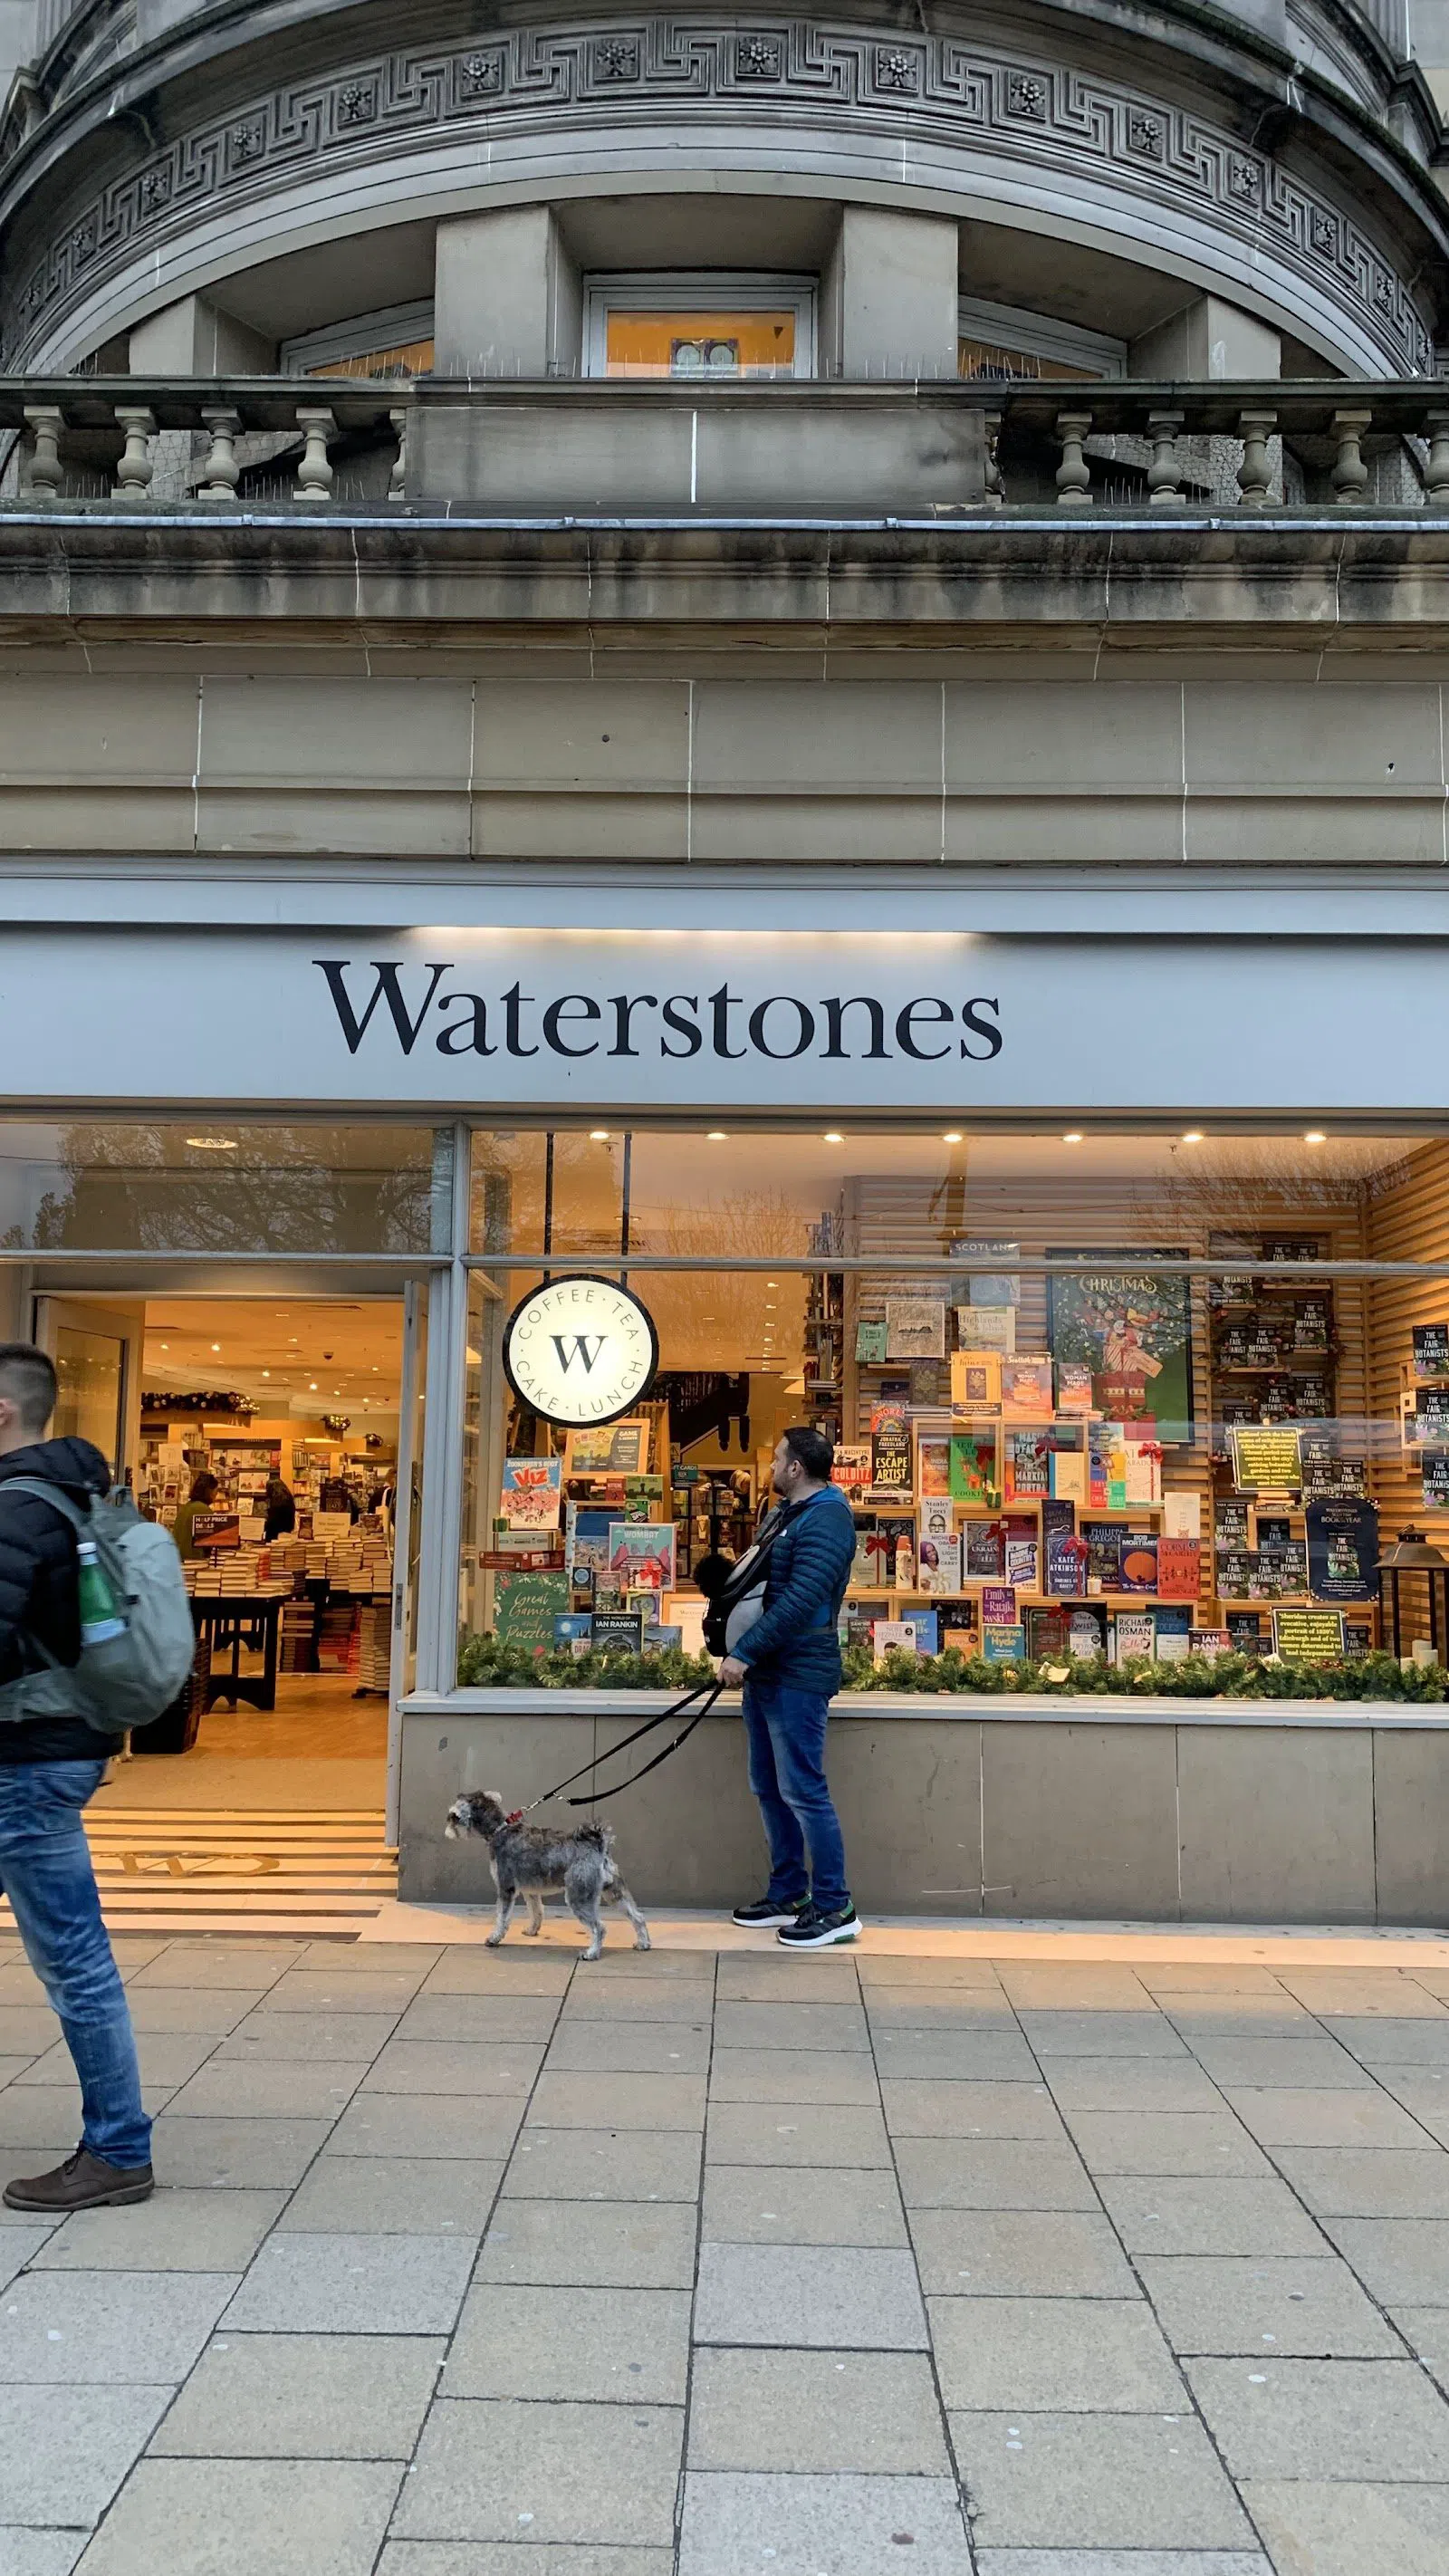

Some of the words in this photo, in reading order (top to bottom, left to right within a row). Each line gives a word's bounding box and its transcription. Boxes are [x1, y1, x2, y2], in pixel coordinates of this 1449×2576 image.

[312, 960, 1003, 1060] Waterstones
[1080, 1274, 1157, 1294] CHRISTMAS
[518, 1289, 595, 1340] COFFEE
[611, 1301, 638, 1340] TEA
[1425, 1331, 1436, 1340] THE
[1424, 1340, 1438, 1349] FAIR
[549, 1335, 609, 1374] W
[1415, 1349, 1449, 1359] BOTANISTS
[516, 1360, 560, 1411] CAKE
[578, 1360, 643, 1417] LUNCH
[1261, 1404, 1285, 1412] BOTANIST
[1426, 1405, 1441, 1413] FAIR
[876, 1456, 908, 1469] ESCAPE
[1435, 1462, 1445, 1470] THE
[834, 1467, 870, 1481] COLDITZ
[877, 1468, 907, 1480] ARTIST
[1015, 1471, 1048, 1481] MARRIA
[1434, 1470, 1447, 1479] FAIR
[1016, 1483, 1046, 1492] PORTRA
[1226, 1508, 1236, 1516] THE
[1224, 1516, 1238, 1524] FAIR
[1215, 1524, 1247, 1533] BOTANISTS
[1229, 1556, 1239, 1564] THE
[1260, 1557, 1270, 1565] THE
[1050, 1563, 1083, 1572] ATKINSON
[1258, 1565, 1271, 1573] FAIR
[1218, 1572, 1245, 1581] BOTANIST
[1250, 1573, 1281, 1582] BOTANISTS
[514, 1593, 549, 1605] Great
[984, 1589, 1005, 1600] Emily
[509, 1606, 552, 1620] Games
[1118, 1619, 1147, 1627] RiCHAR
[506, 1625, 552, 1641] Puzzles
[985, 1627, 1022, 1637] Marina
[1118, 1628, 1151, 1636] OSMAN
[991, 1637, 1016, 1647] Hyde
[1202, 1635, 1220, 1643] IAN
